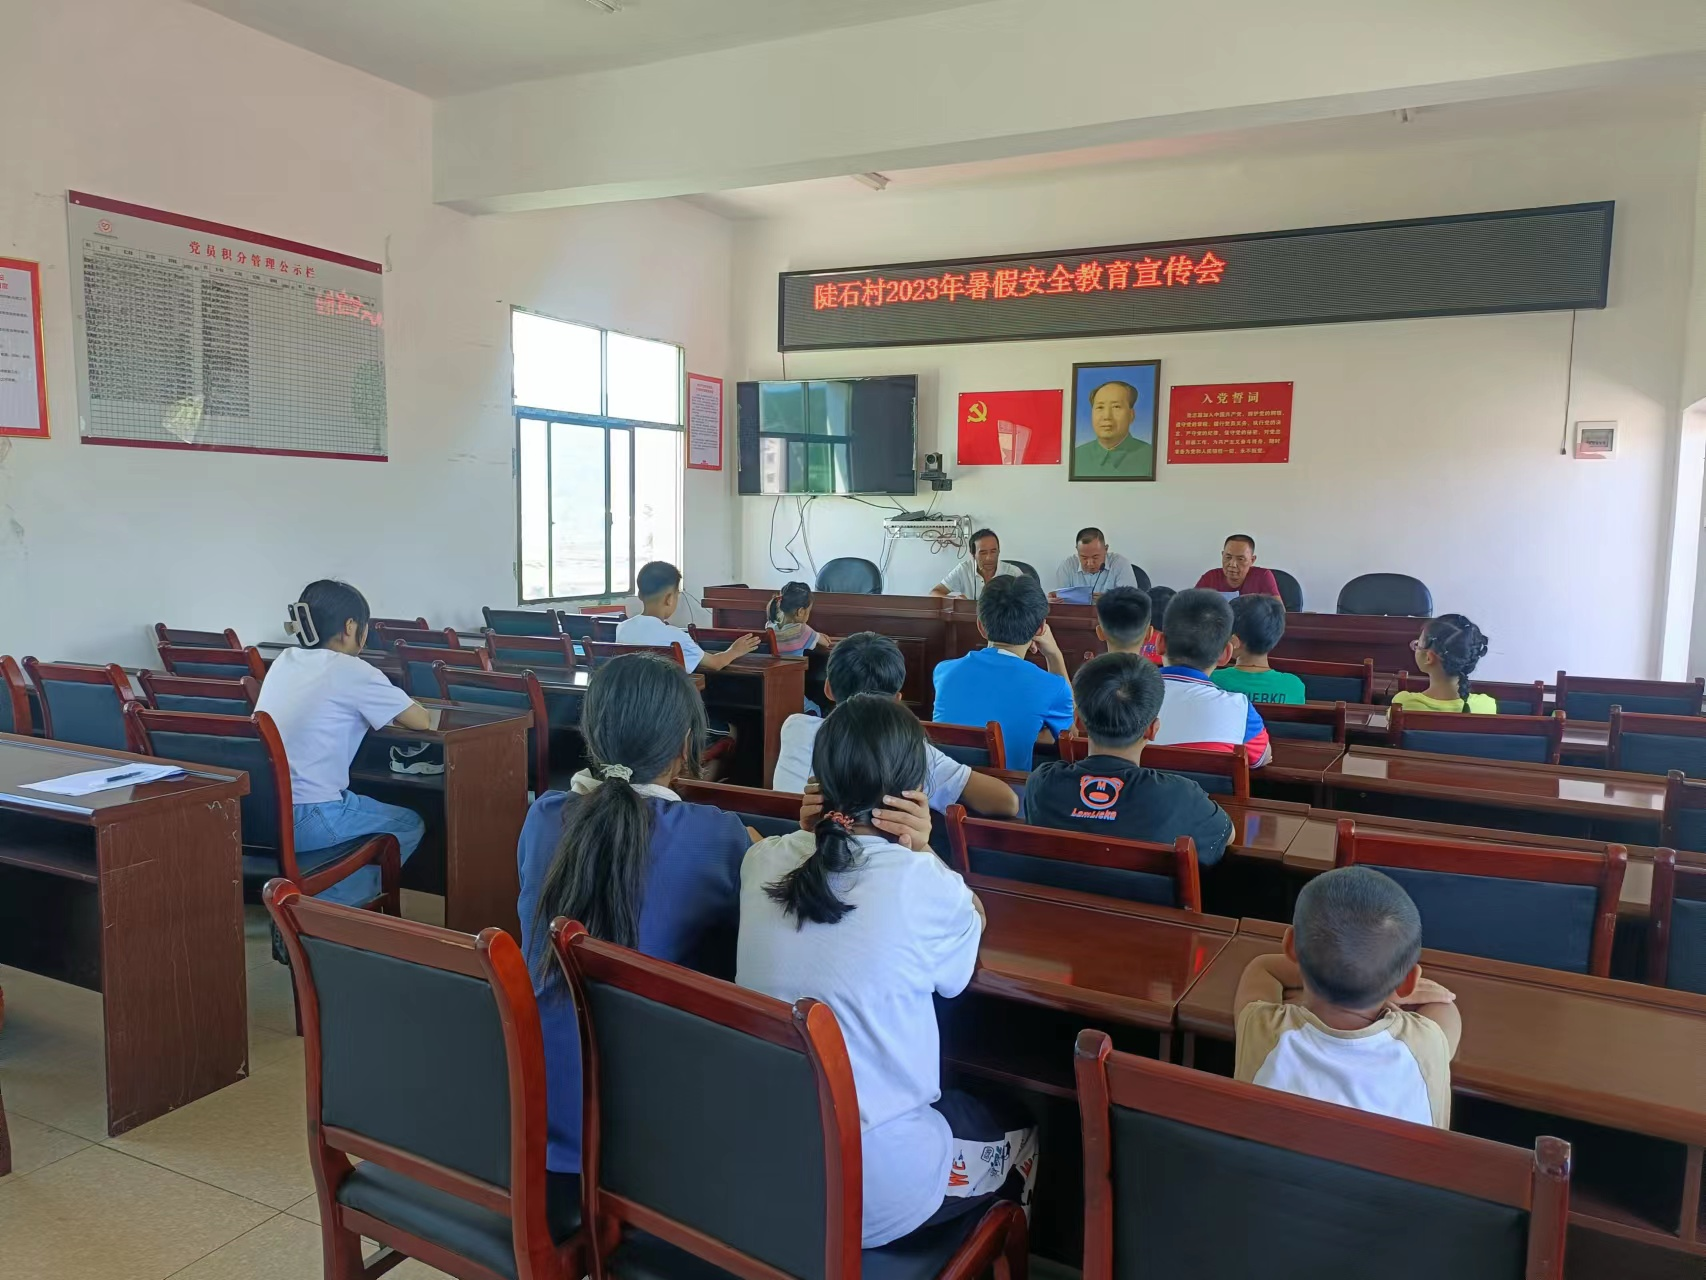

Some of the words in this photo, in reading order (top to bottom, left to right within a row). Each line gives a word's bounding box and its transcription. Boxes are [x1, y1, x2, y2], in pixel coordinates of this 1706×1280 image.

[189, 240, 317, 278] 党员积分管理公示栏
[813, 251, 1226, 310] 陡石村2023年暑假安全教育宣传会
[1202, 391, 1259, 404] 入党誓词
